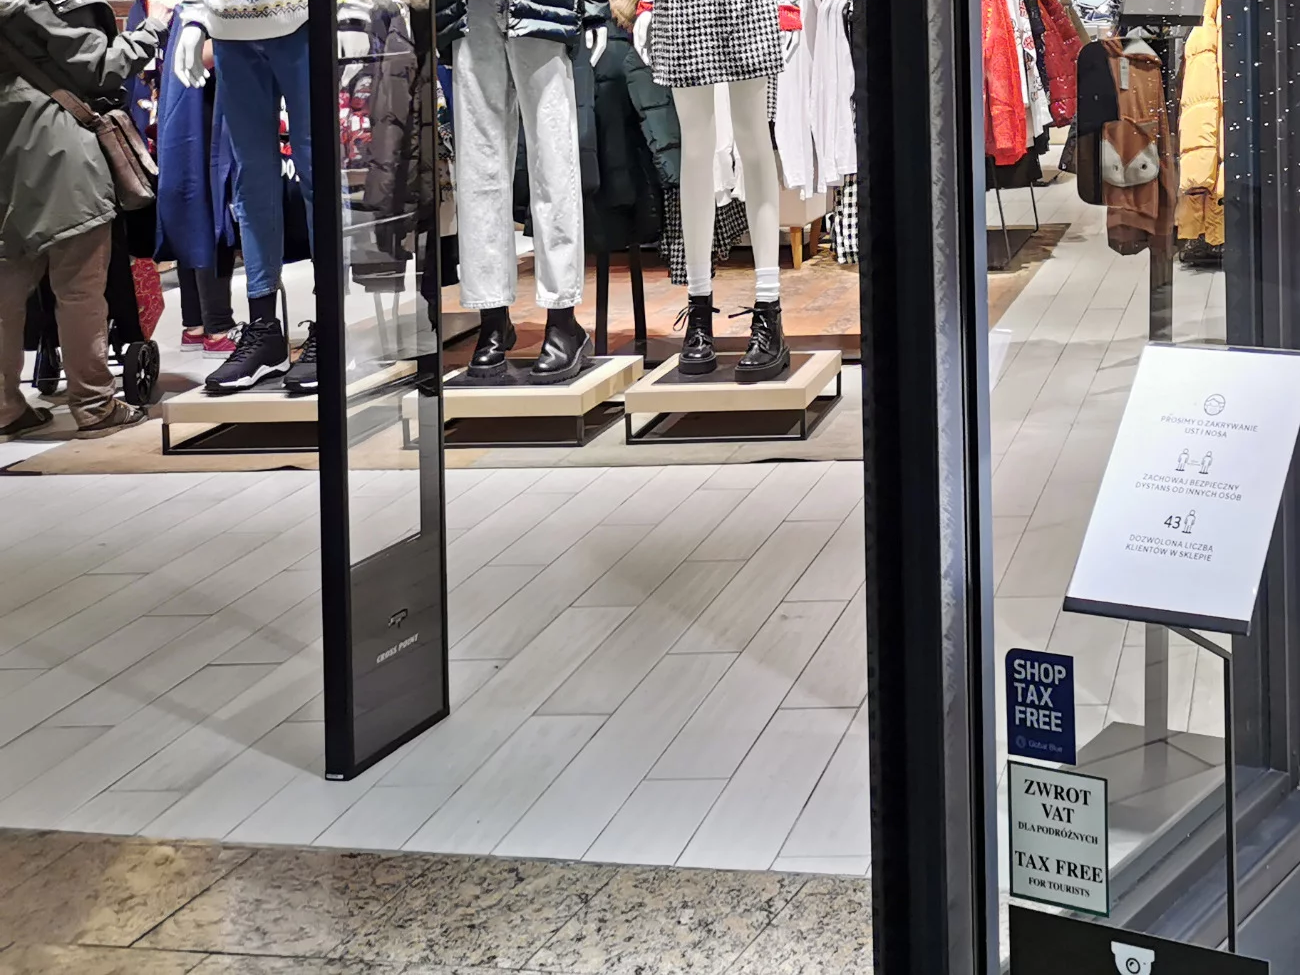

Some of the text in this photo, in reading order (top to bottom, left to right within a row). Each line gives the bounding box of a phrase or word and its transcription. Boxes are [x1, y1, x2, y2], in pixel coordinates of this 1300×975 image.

[1161, 415, 1196, 426] PROSIMY
[1205, 420, 1258, 432] ZAKRYWANIE
[1184, 428, 1200, 436] UST
[1204, 430, 1227, 438] NOSA
[1135, 482, 1242, 501] DYSTANS OD INNYCH OSÓB
[1143, 473, 1240, 491] ZACHOWAJ BEZPIECZNY
[1163, 515, 1182, 529] 43
[1125, 543, 1168, 556] KLIENTÓW
[1179, 551, 1212, 562] SKLEPIE
[1129, 533, 1213, 553] DOZWOLONA LICZBA
[1013, 658, 1067, 685] SHOP
[1013, 681, 1053, 708] TAX
[1015, 705, 1062, 733] FREE
[1024, 778, 1091, 806] ZWROT
[1041, 803, 1075, 824] VAT
[1018, 821, 1098, 845] DLA PODRÓŻNYCH
[1014, 850, 1103, 884] TAX FREE
[1028, 877, 1090, 898] FOR TOURISTS
